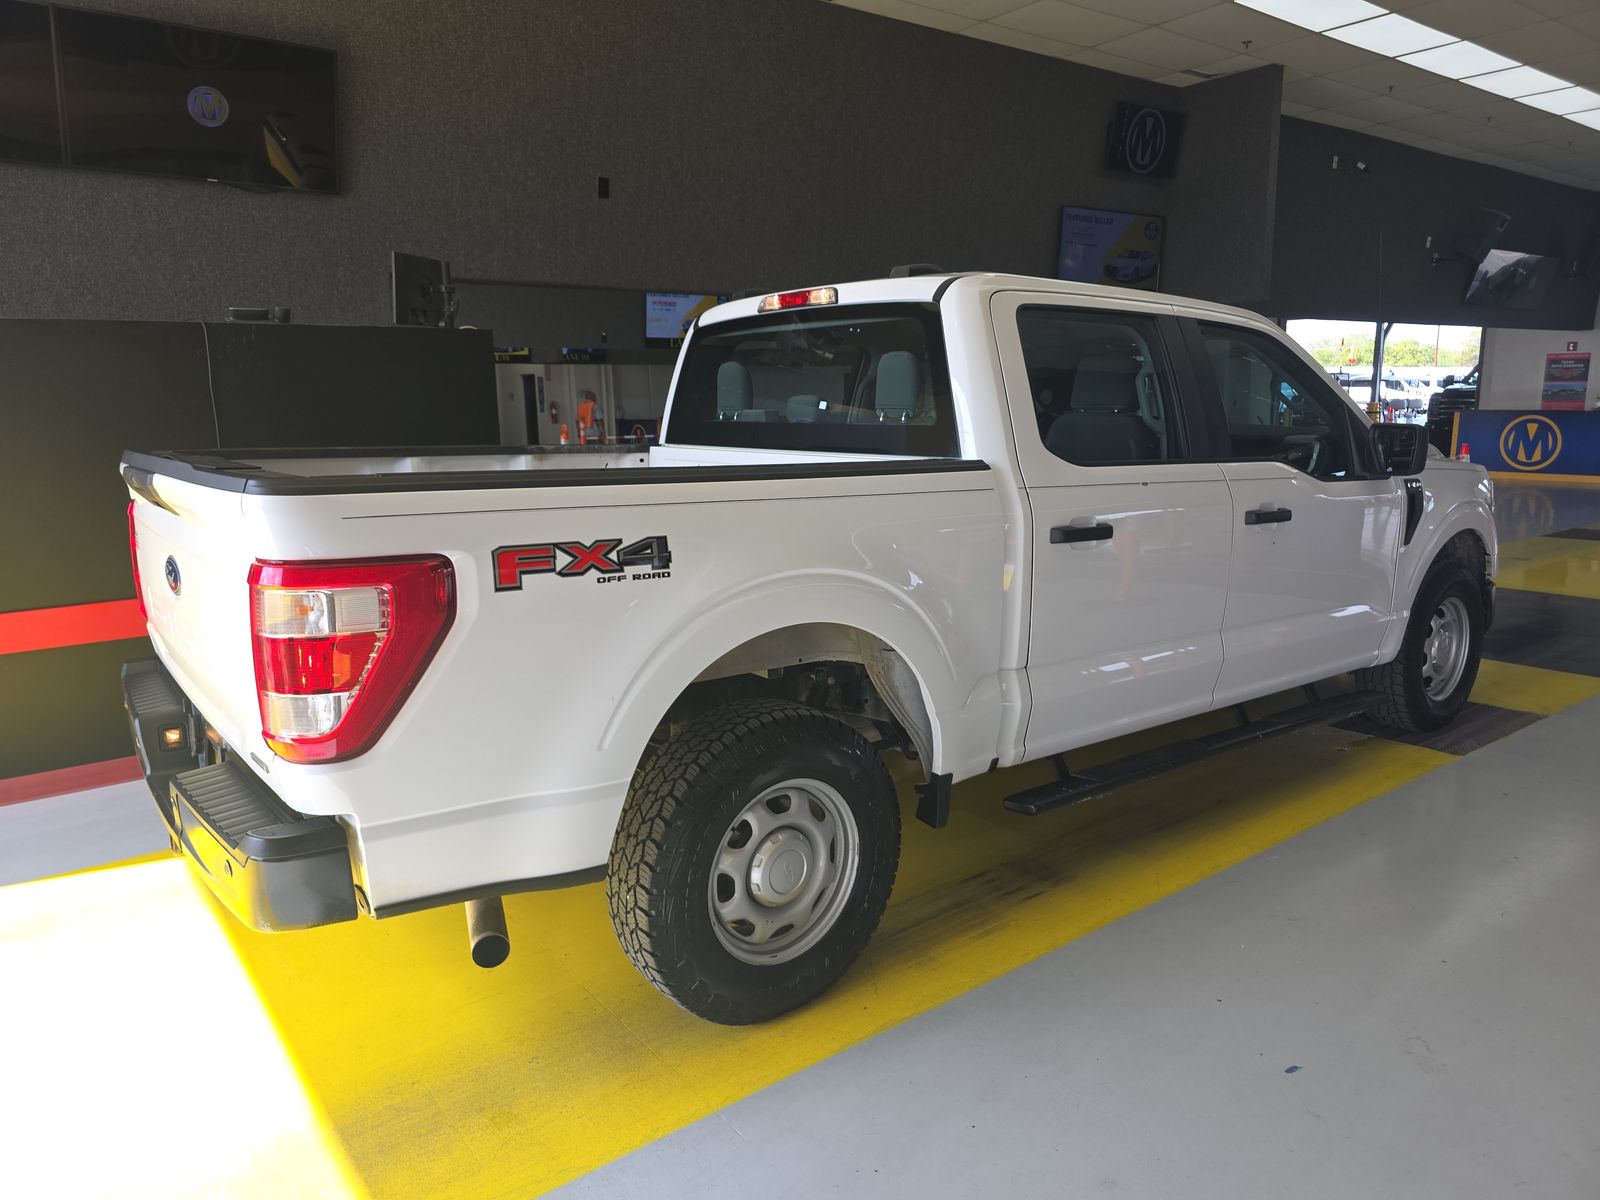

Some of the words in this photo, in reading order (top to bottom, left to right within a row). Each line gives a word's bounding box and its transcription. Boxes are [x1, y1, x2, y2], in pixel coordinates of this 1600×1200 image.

[491, 536, 672, 592] FX4
[596, 575, 627, 584] OFF
[632, 571, 671, 581] ROAD
